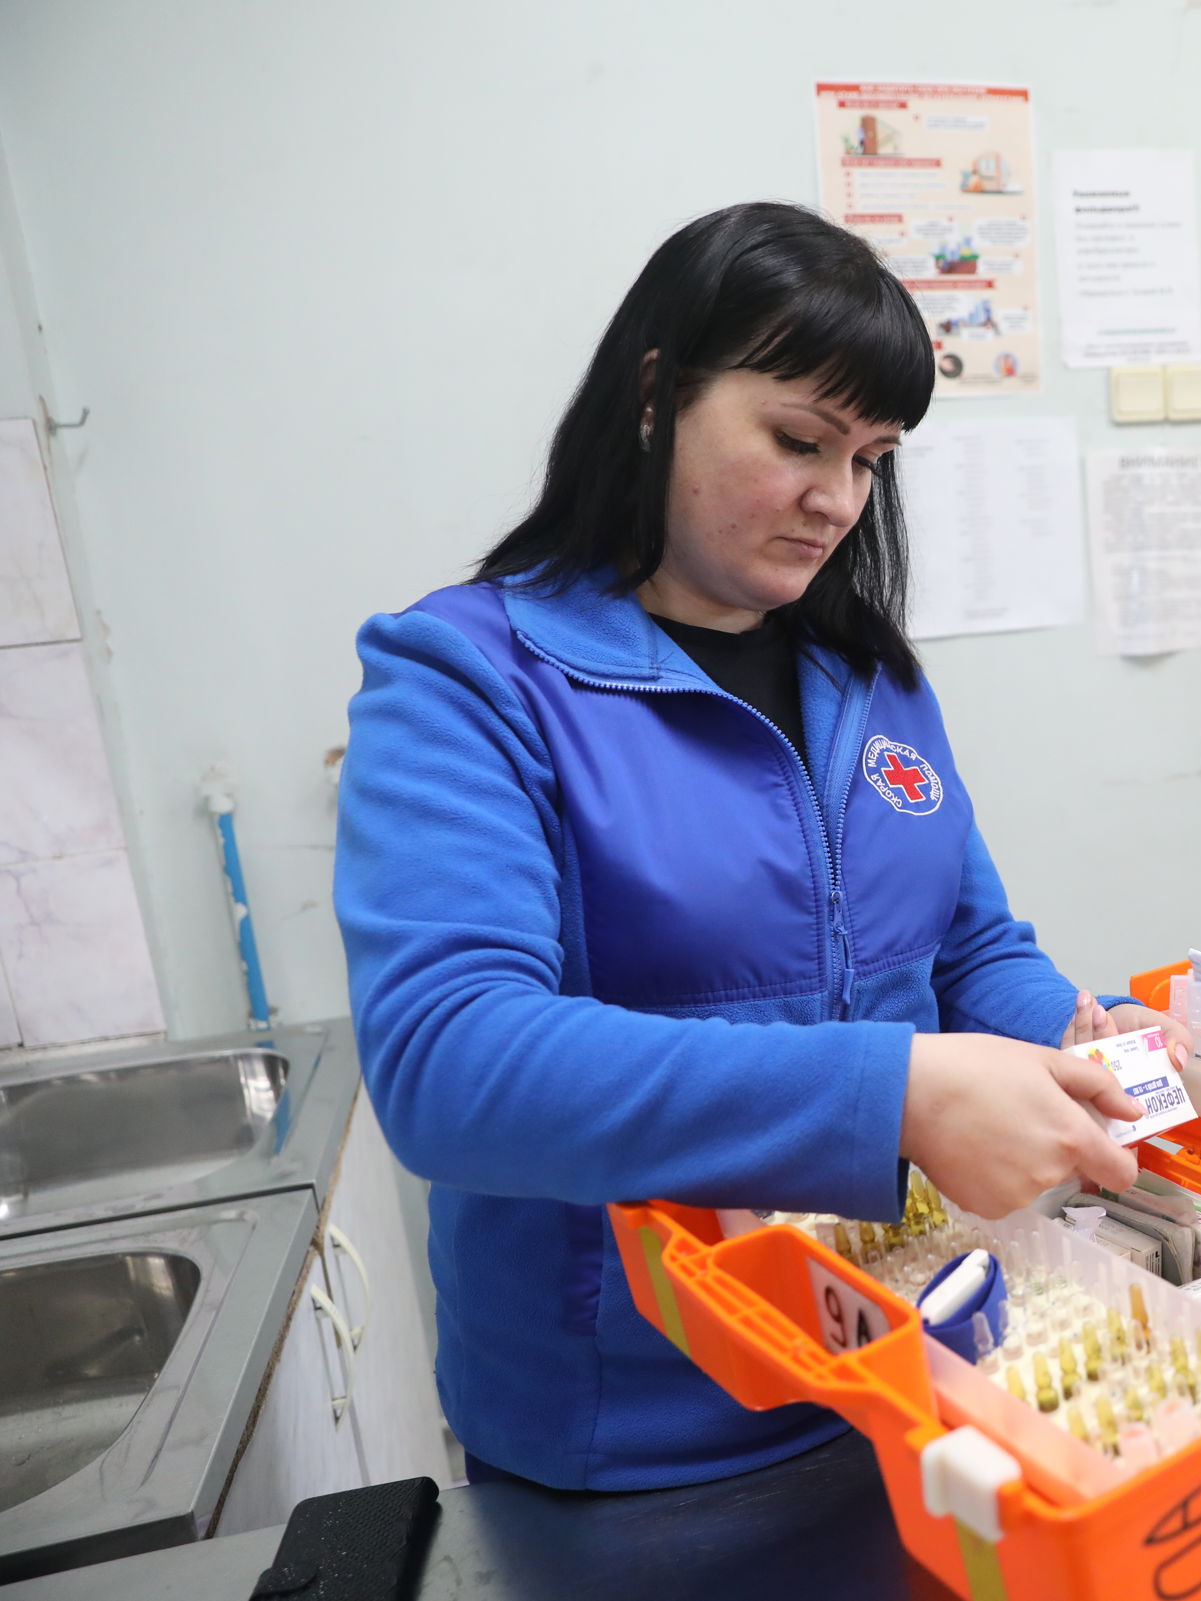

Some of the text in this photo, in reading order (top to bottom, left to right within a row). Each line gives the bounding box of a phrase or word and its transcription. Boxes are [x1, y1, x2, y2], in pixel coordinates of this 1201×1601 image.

[867, 740, 940, 807] СКОРАЯ МЕДИЦИНСКАЯ ПОМОЩЬ
[1145, 1085, 1186, 1114] ЦЕФЕКОН
